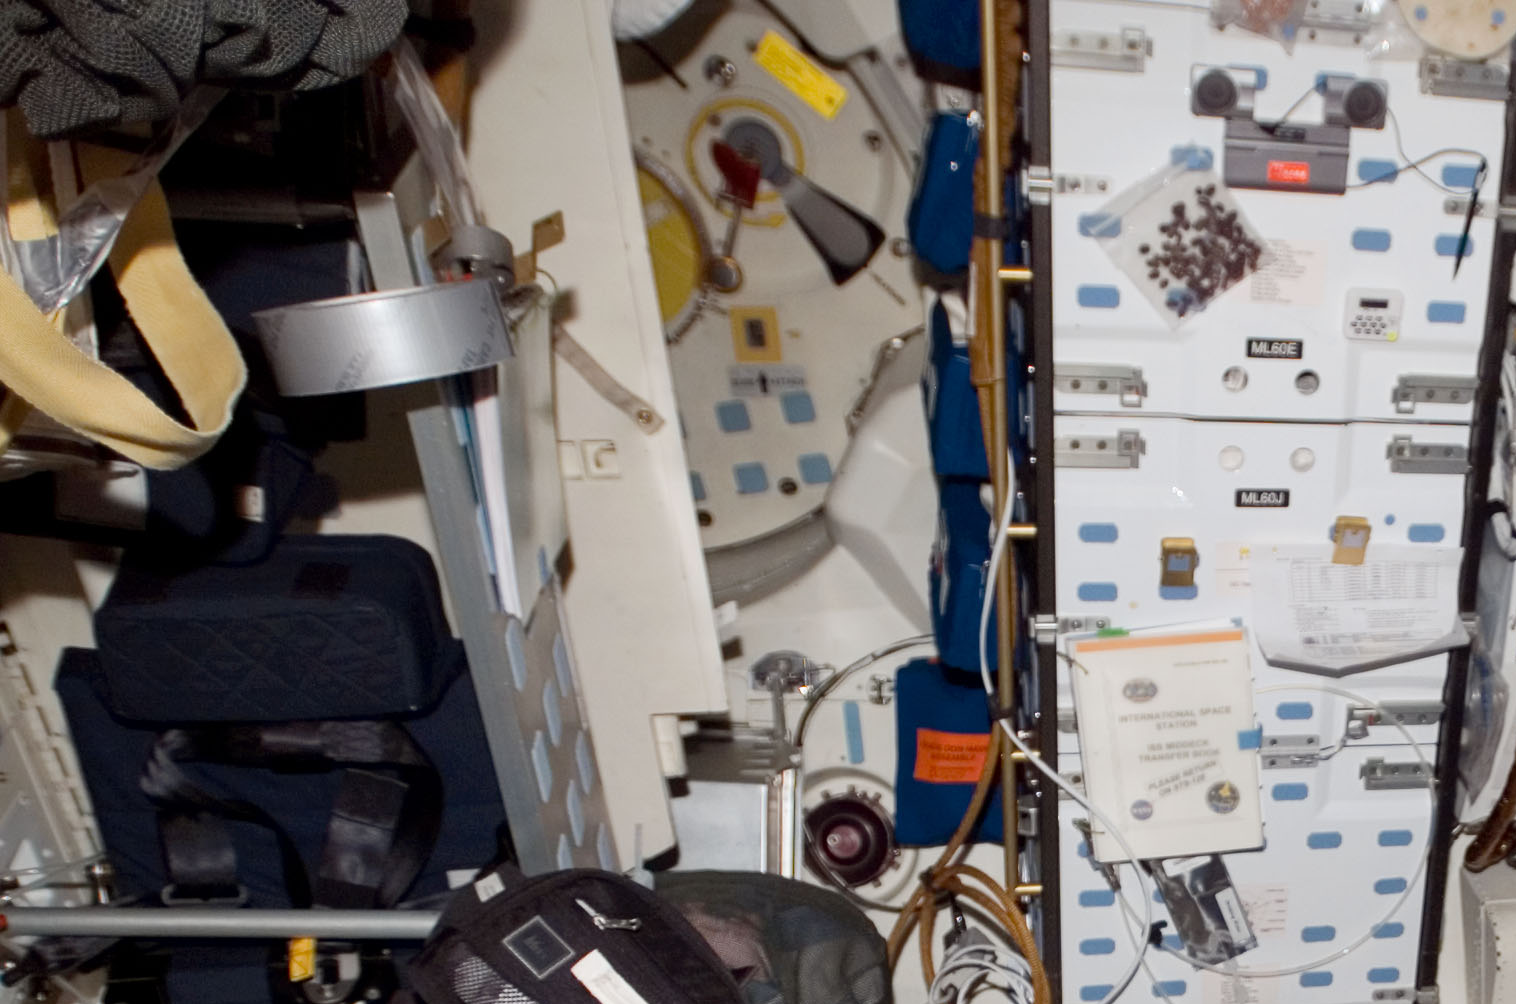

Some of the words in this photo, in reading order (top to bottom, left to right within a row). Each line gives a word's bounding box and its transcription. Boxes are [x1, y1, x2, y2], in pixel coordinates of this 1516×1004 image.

[1250, 341, 1298, 355] ML60E
[1118, 709, 1196, 723] INTERNATIONAL
[1199, 704, 1232, 717] SPACE
[1155, 719, 1198, 731] STATION
[1165, 739, 1209, 750] MIDDECK
[1138, 752, 1190, 763] TRANSFER
[1148, 774, 1182, 790] PLEASE
[1182, 760, 1217, 777] RETURN
